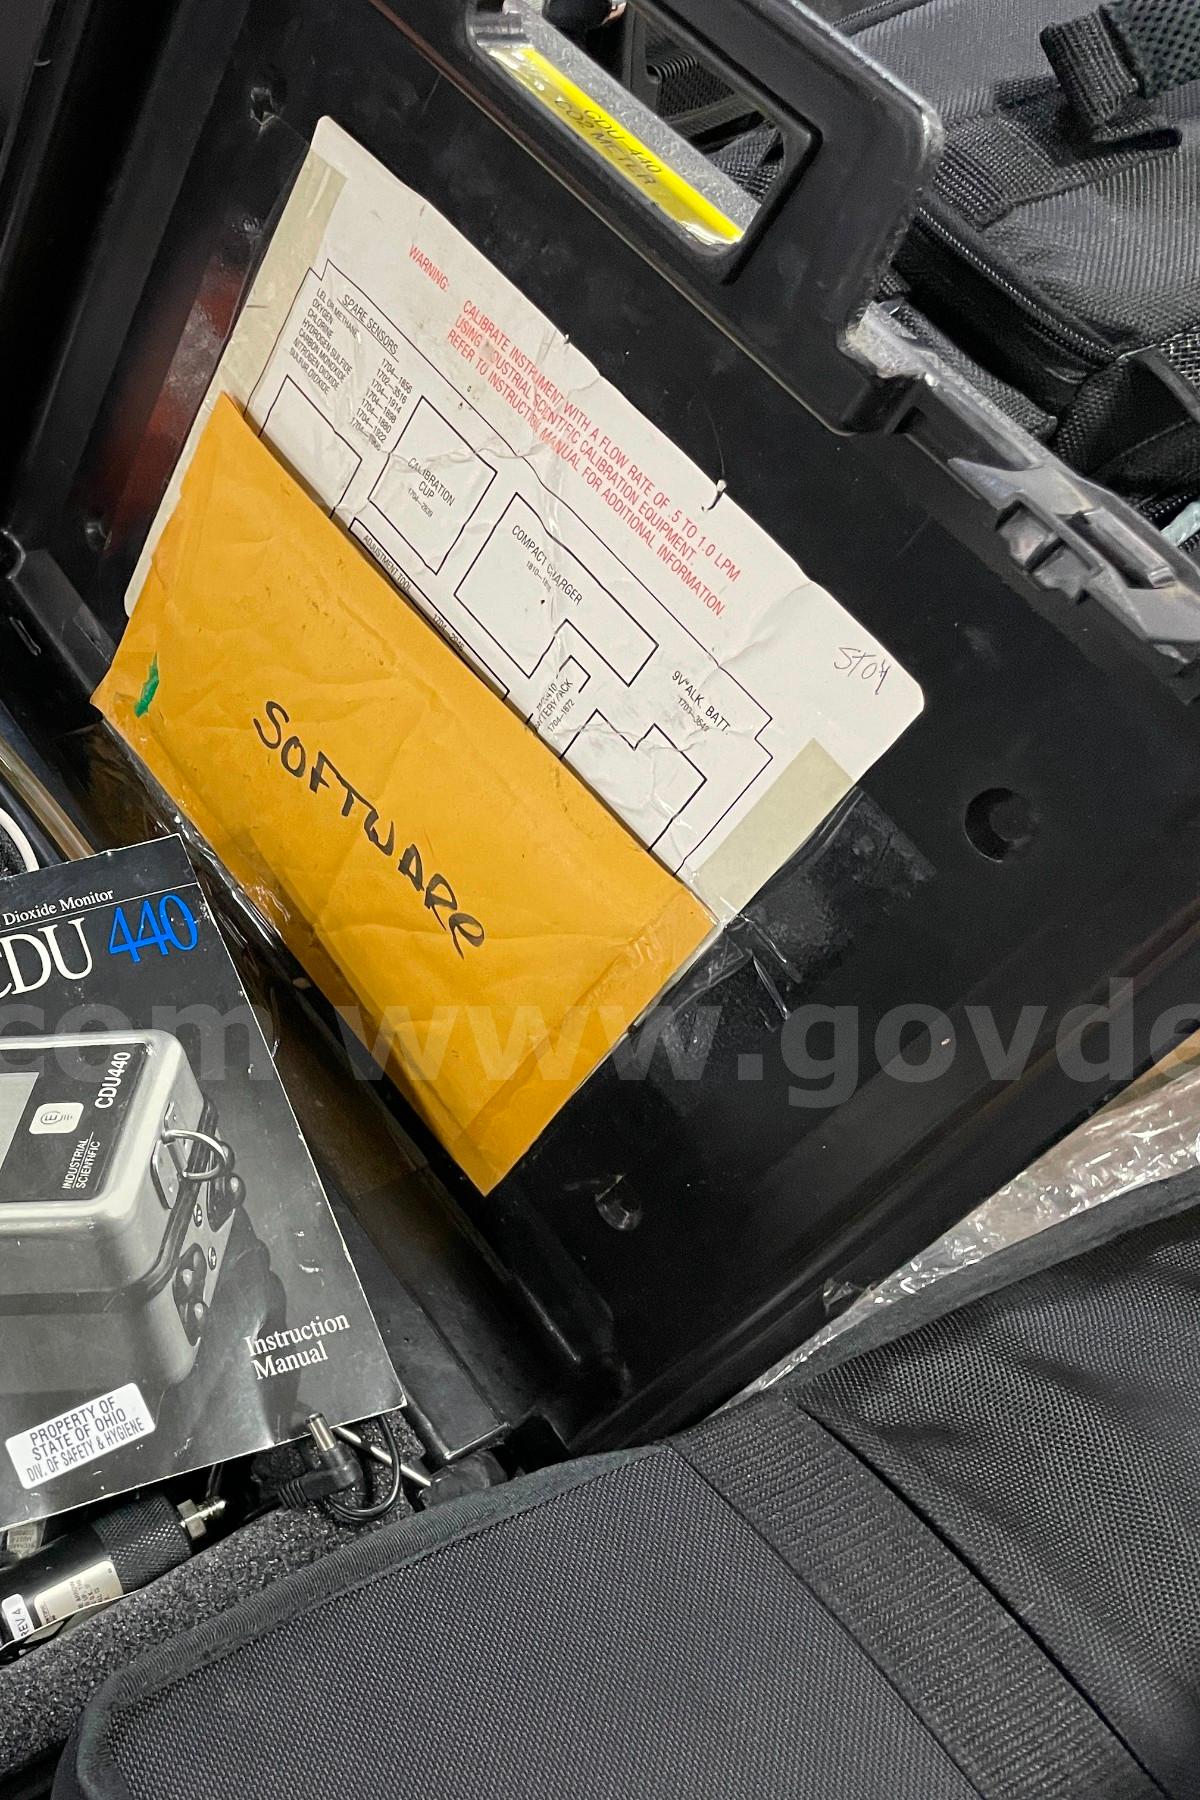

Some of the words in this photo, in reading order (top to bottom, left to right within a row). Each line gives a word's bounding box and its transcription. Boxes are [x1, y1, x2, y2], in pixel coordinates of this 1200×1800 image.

[409, 243, 451, 293] WARNING:
[307, 308, 334, 340] CHLORINE
[312, 298, 334, 326] OXYGEN
[342, 294, 369, 322] SPARE
[366, 318, 399, 355] SENSORS
[292, 337, 320, 370] NITROGEN
[318, 363, 340, 392] DIOXIDE
[299, 328, 319, 355] CARBON
[318, 351, 346, 386] MONOXIDE
[302, 318, 332, 352] HYDROGEN
[329, 347, 353, 377] SULFIDE
[307, 368, 332, 397] DIOXIDE
[455, 314, 483, 349] USING
[486, 345, 532, 399] DUSTRIAL
[532, 392, 581, 444] SCIENTIFIC
[581, 440, 640, 506] CALIBRATION
[638, 502, 698, 566] EQUIPMENT.
[463, 299, 511, 353] CALIBRATE
[509, 345, 565, 408] INSTRUMENT
[564, 401, 592, 432] WITH
[590, 428, 600, 442] A
[600, 435, 630, 469] FLOW
[627, 464, 656, 496] RATE
[653, 491, 671, 510] OF
[681, 518, 698, 539] TO
[697, 536, 717, 558] 1.0
[714, 552, 742, 583] LPM
[407, 457, 456, 507] CALIBRATION
[417, 480, 435, 500] CUP
[448, 329, 476, 363] REFER
[475, 358, 489, 376] TO
[539, 427, 585, 472] MANUAL
[581, 466, 603, 493] FOR
[601, 488, 658, 550] ADDITIONAL
[656, 543, 727, 619] INFORMATION.
[363, 534, 398, 576] ADJUSTMENT
[396, 572, 411, 592] TOOL
[511, 524, 548, 567] COMPACT
[704, 705, 731, 735] BATT.
[2, 904, 57, 926] Dioxide
[59, 888, 114, 911] Monitor
[108, 894, 198, 964] 440
[95, 1050, 132, 1110] CDU440
[62, 1136, 89, 1191] INDUSTRIAL
[75, 1139, 102, 1191] SCIENTIFIC
[243, 1313, 350, 1358] Instruction
[250, 1340, 329, 1381] Manual
[29, 1404, 95, 1447] PROPERTY
[99, 1395, 116, 1414] OF
[32, 1432, 73, 1461] STATE
[75, 1423, 91, 1442] OF
[95, 1407, 127, 1432] OHIO
[26, 1463, 48, 1482] DIV.
[47, 1457, 60, 1474] OF
[60, 1439, 95, 1467] SAFETY
[96, 1435, 105, 1450] &
[104, 1417, 145, 1447] HYGIENE
